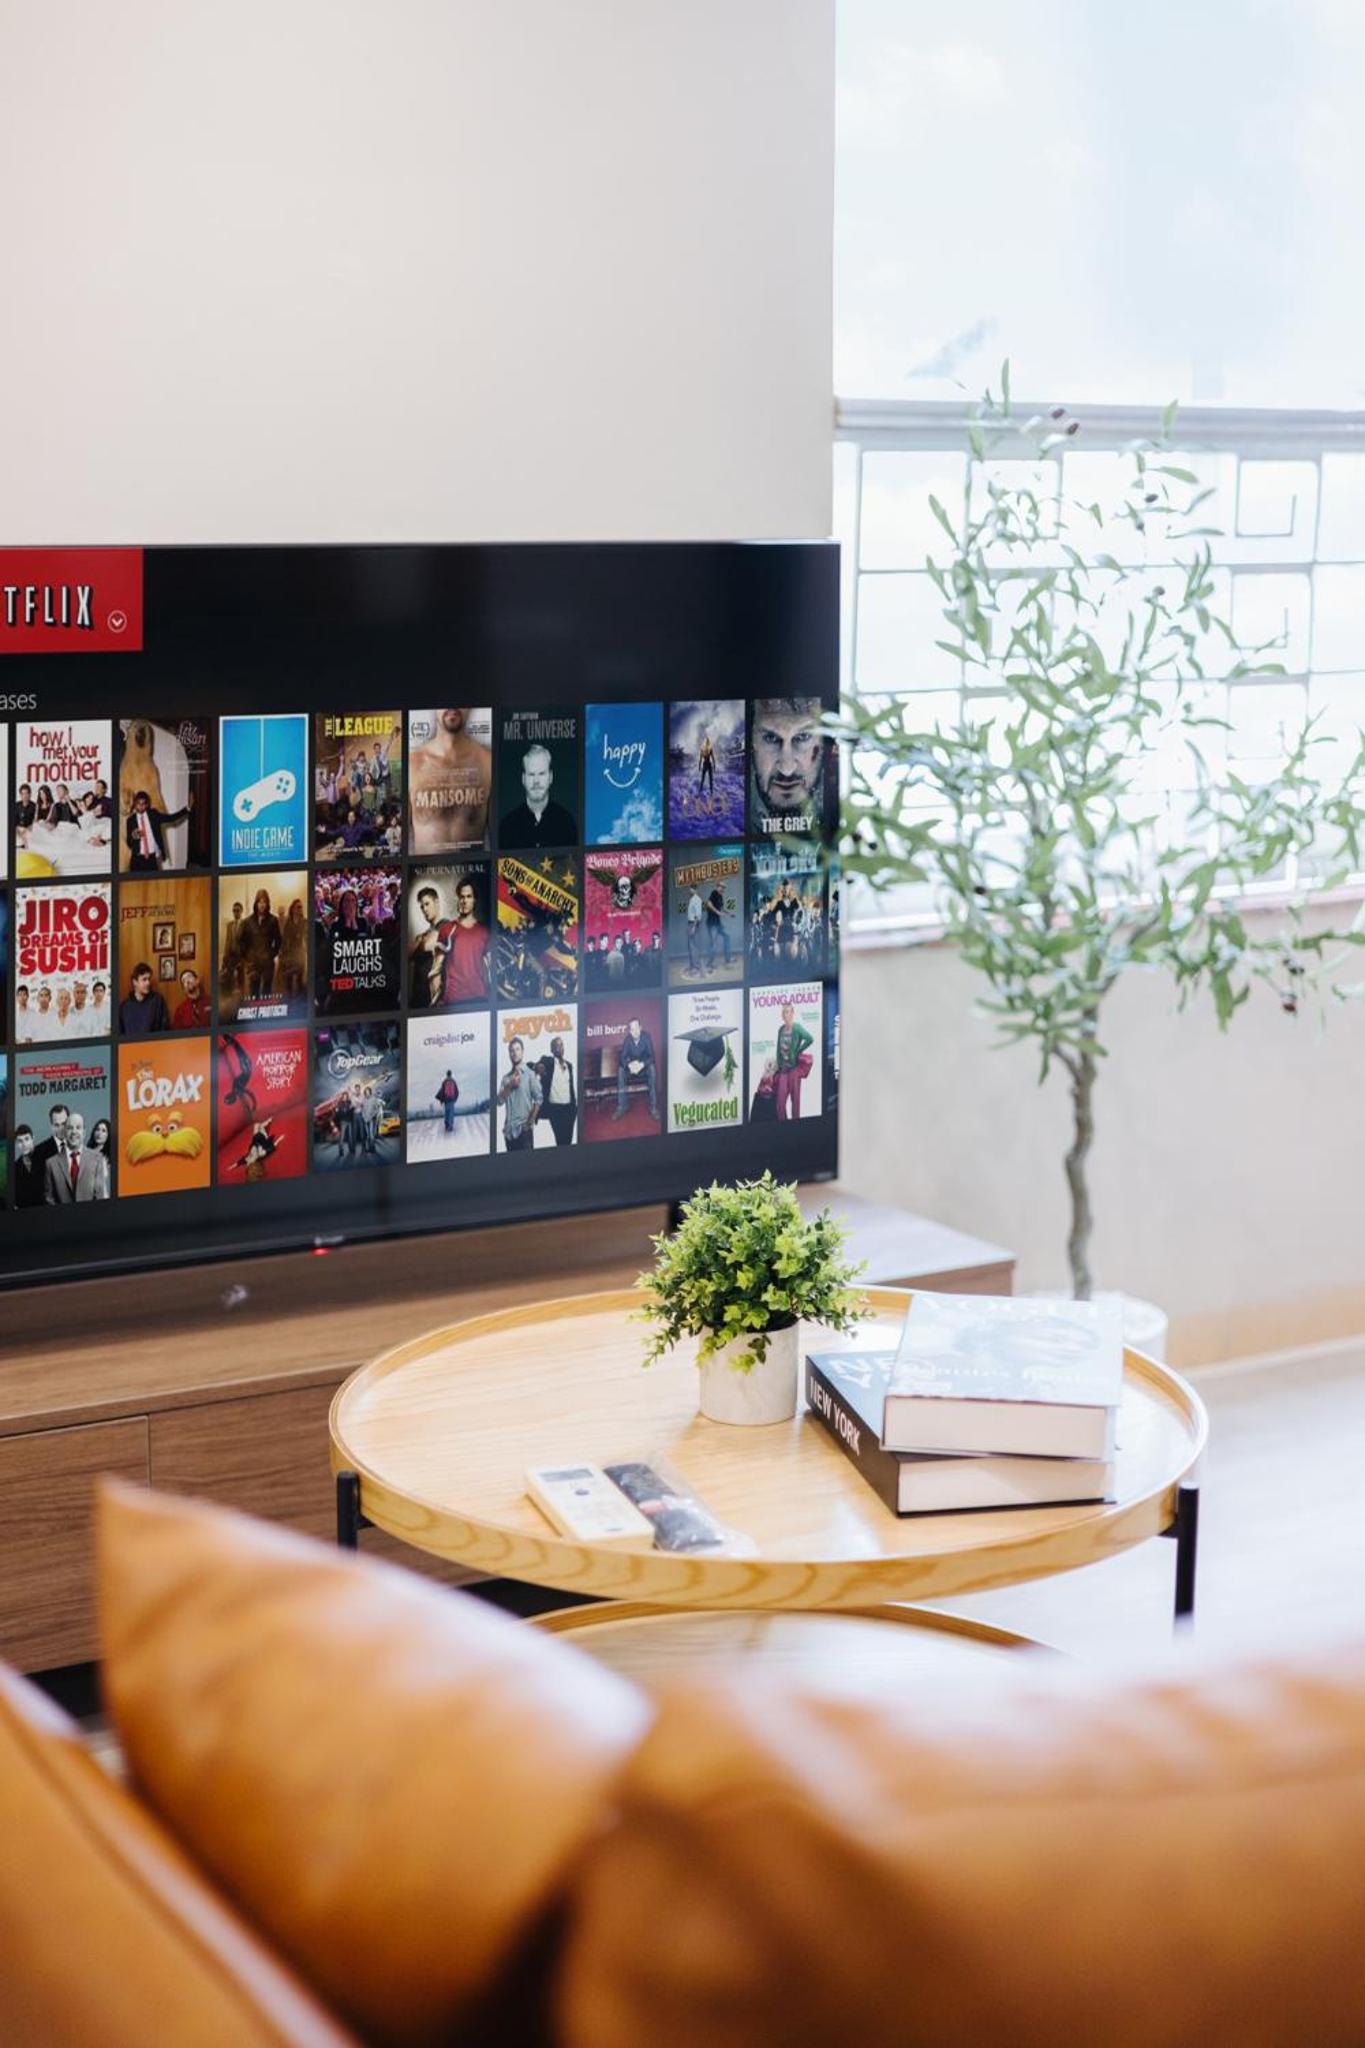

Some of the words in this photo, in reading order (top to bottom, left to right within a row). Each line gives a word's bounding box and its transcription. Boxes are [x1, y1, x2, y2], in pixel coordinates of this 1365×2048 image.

[335, 716, 393, 736] LEAGUE
[527, 719, 577, 739] UNIVERSE
[29, 727, 63, 748] how
[43, 744, 67, 760] met
[71, 745, 99, 763] your
[603, 733, 646, 768] happy
[27, 757, 101, 782] mother
[762, 818, 783, 833] THE
[231, 829, 261, 851] INDIE
[263, 826, 295, 849] GAME
[502, 859, 527, 885] SONS
[532, 880, 576, 914] ANARCHY
[18, 896, 109, 934] JIRO
[20, 932, 83, 949] DREAMS
[88, 930, 108, 945] OF
[333, 938, 382, 958] SMART
[19, 944, 108, 976] SUSHI
[333, 955, 382, 975] LAUGHS
[752, 994, 788, 1009] YOUNG
[789, 992, 820, 1004] ADULT
[19, 1081, 47, 1097] TODD
[49, 1076, 107, 1094] MARGARET
[126, 1072, 204, 1111] LORAX
[673, 1096, 738, 1127] Vegucated
[810, 1375, 832, 1420] NEW
[834, 1402, 860, 1457] YORK
